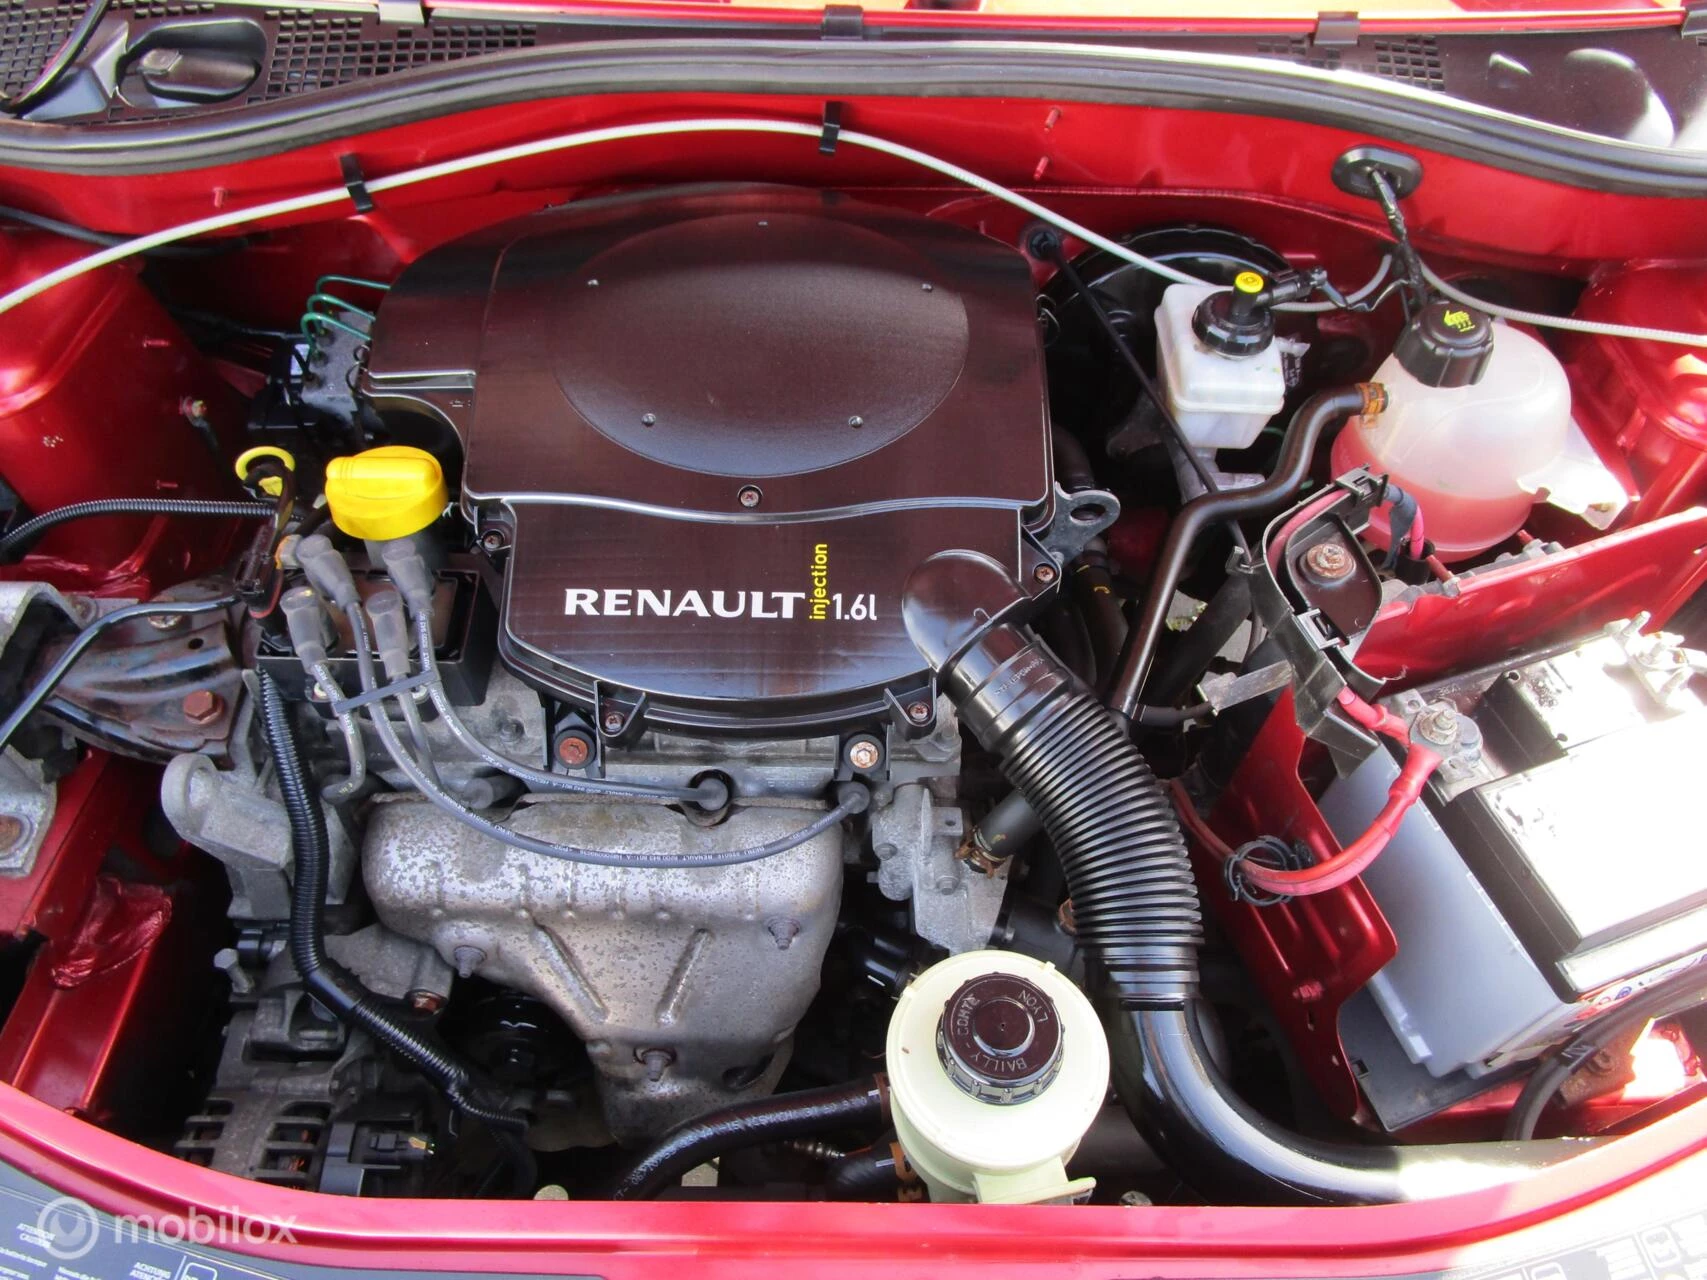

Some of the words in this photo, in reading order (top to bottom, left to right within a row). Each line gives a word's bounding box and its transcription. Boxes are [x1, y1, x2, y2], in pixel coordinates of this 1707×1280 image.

[808, 543, 828, 620] injection
[563, 587, 807, 620] RENAULT
[1017, 989, 1049, 1023] LYON
[972, 1052, 1027, 1073] BAILLY
